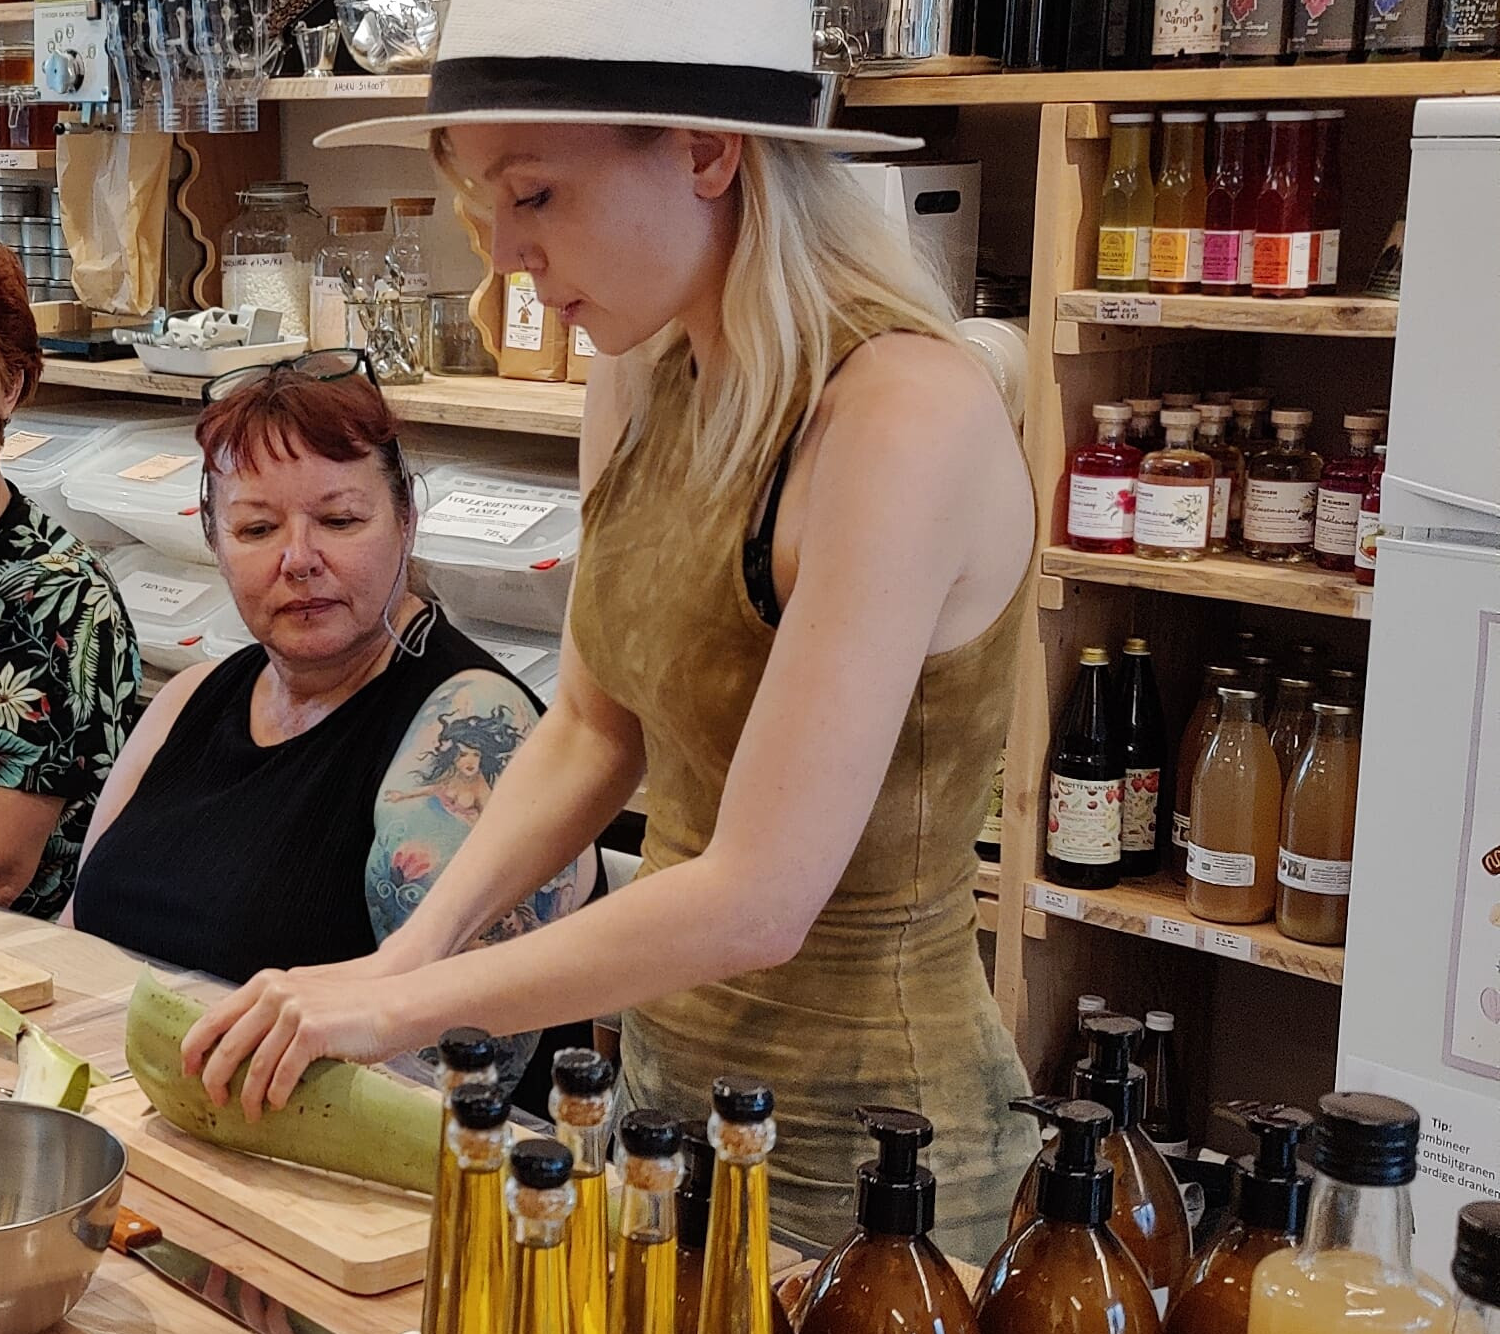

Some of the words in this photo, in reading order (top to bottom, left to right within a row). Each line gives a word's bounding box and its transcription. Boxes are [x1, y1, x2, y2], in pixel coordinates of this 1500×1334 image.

[1164, 11, 1204, 27] Sangria
[1431, 1116, 1452, 1133] Tip:
[1419, 1131, 1471, 1155] ombineer
[1419, 1163, 1455, 1183] ardige
[1423, 1149, 1496, 1180] ontbijtgranen
